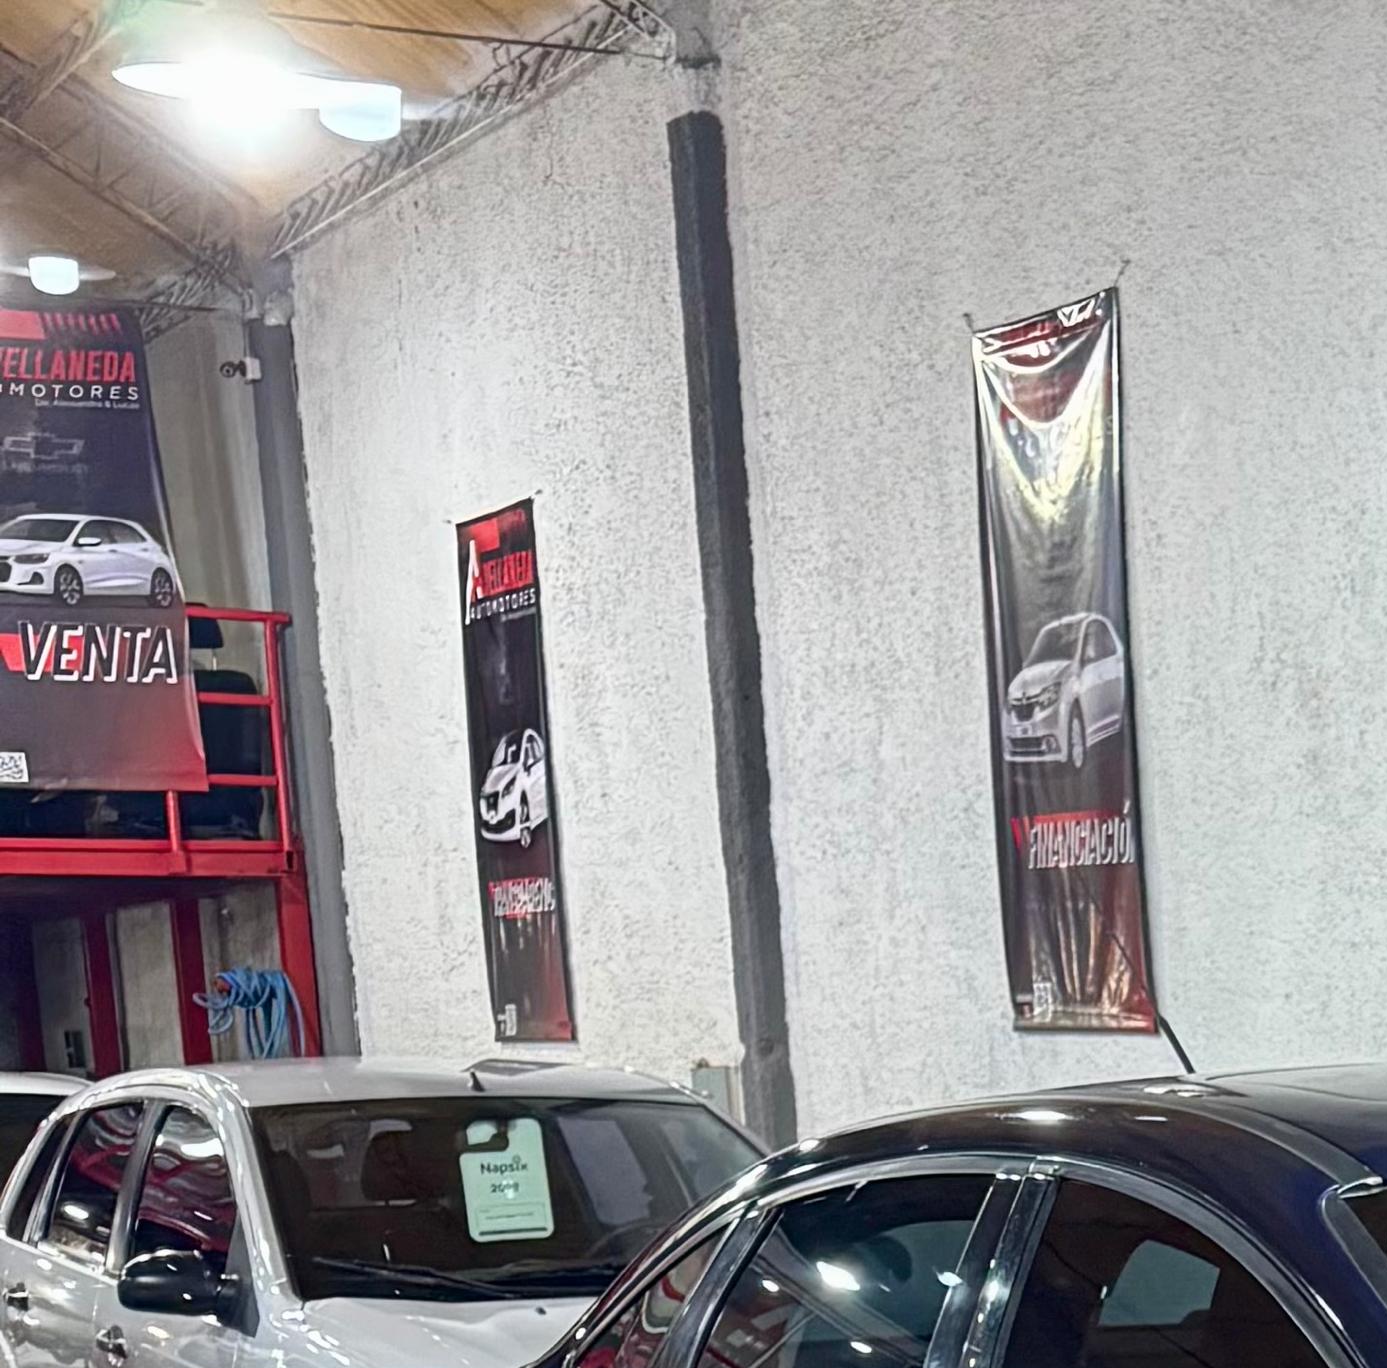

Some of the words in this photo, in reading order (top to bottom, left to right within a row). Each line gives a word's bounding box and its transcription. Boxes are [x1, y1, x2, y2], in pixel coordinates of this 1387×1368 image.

[0, 347, 135, 382] ELLANEDA
[0, 382, 139, 400] MOTORES
[18, 619, 179, 684] VENTA
